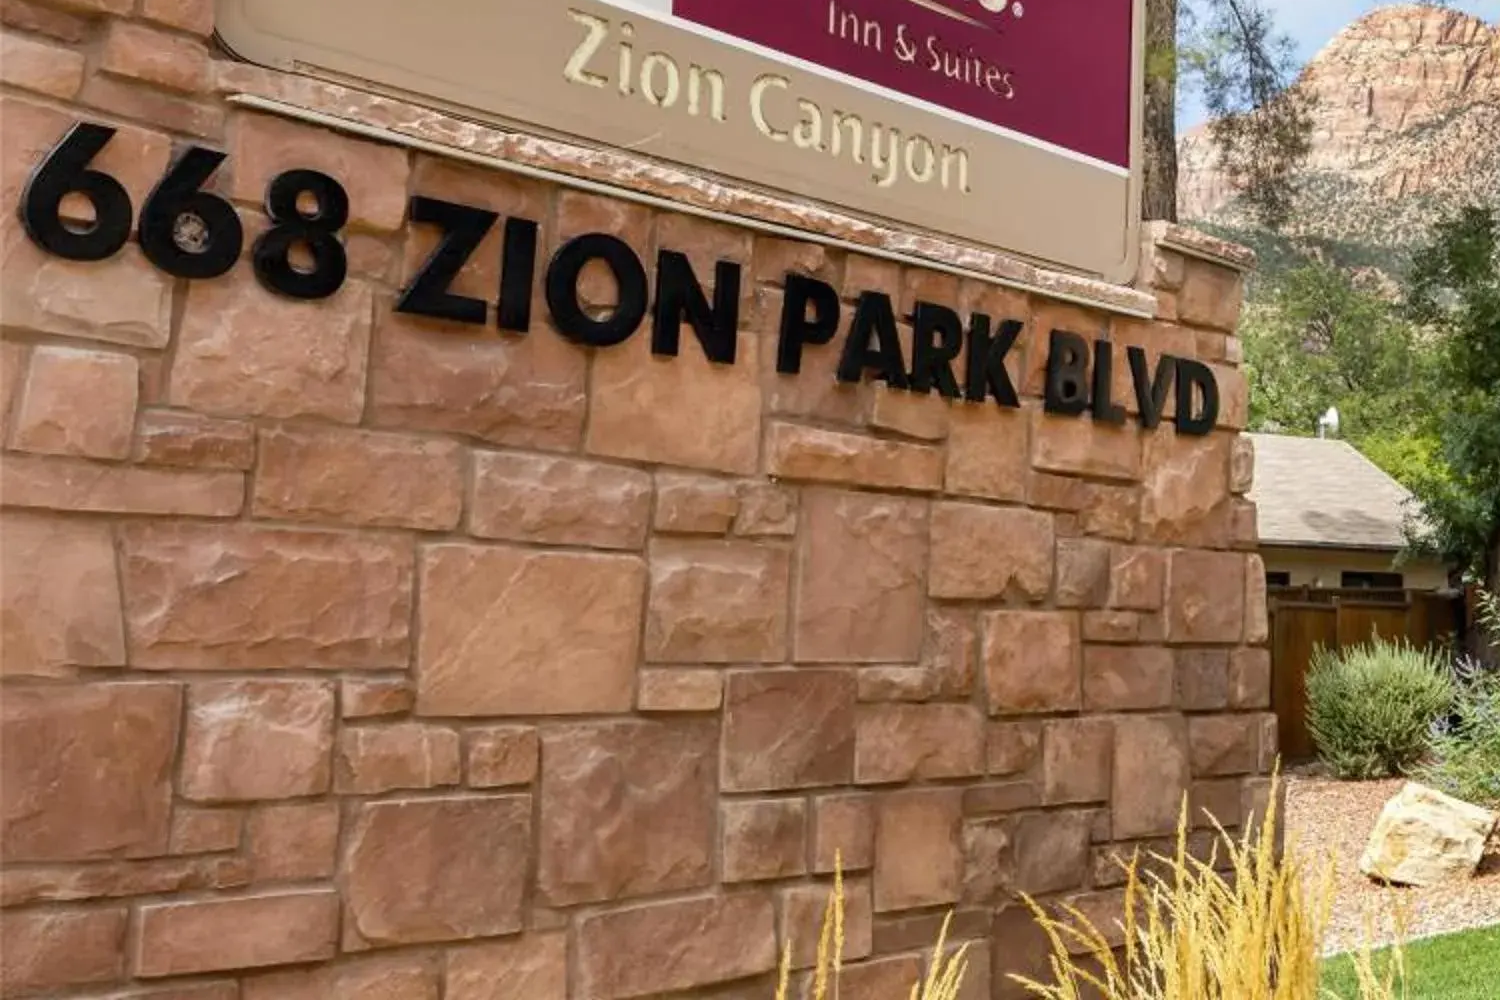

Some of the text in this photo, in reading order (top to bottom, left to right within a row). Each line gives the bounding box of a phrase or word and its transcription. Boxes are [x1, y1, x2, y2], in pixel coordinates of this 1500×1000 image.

[562, 7, 971, 194] Zion Canyon
[828, 0, 1015, 100] Inn & Suites
[22, 120, 1220, 438] 668 ZION PARK BLVD
